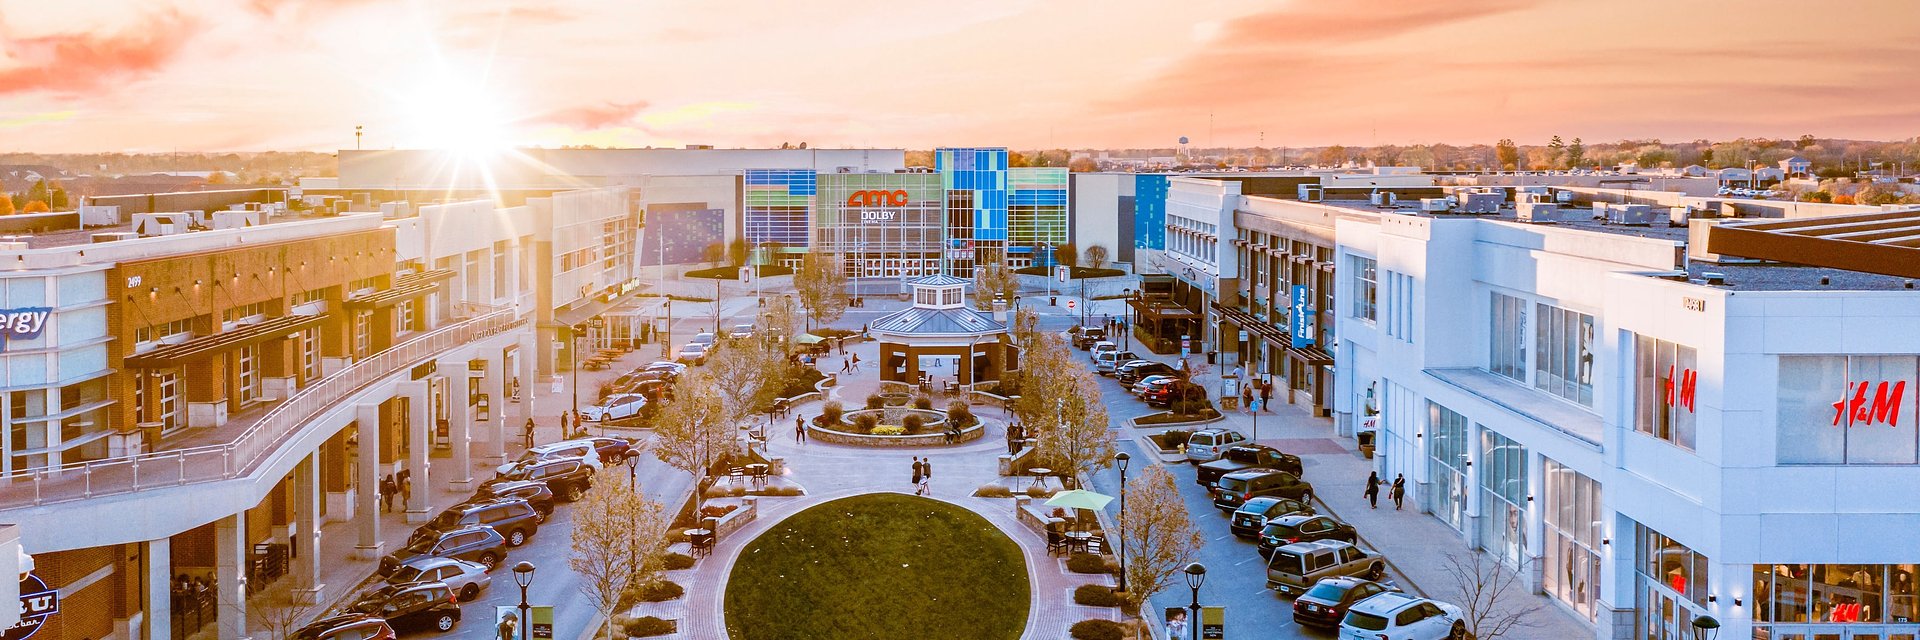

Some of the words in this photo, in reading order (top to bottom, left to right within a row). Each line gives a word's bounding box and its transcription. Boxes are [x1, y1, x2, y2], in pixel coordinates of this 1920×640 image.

[861, 211, 896, 220] DOLBY
[127, 275, 142, 288] 2499
[1832, 380, 1907, 428] H&M
